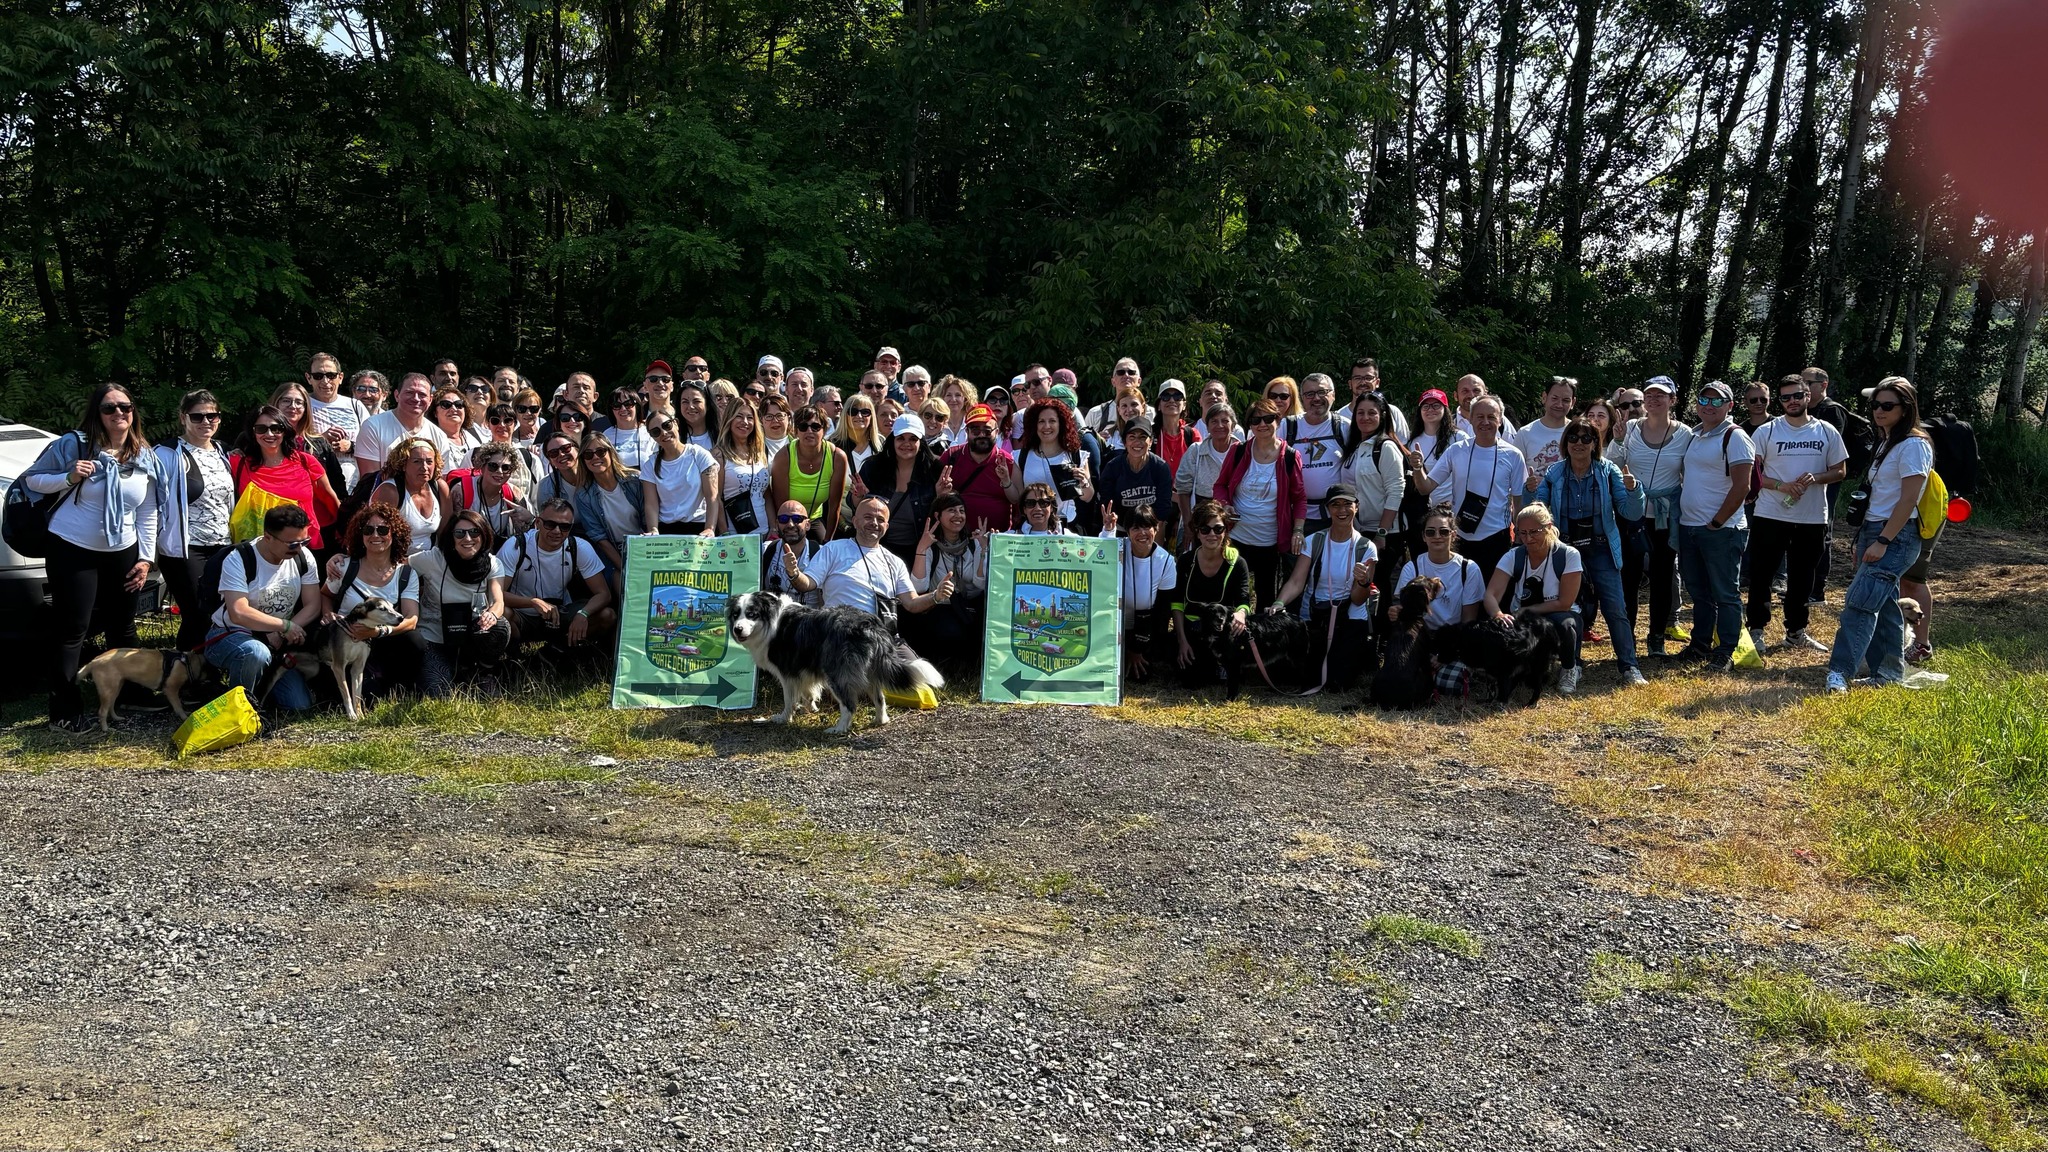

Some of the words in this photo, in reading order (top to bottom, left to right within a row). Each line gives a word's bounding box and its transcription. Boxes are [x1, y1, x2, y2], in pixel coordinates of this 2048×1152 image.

[1776, 440, 1824, 453] THRASHER
[1302, 461, 1334, 469] CONVERSE
[1121, 485, 1157, 499] SEATTLE
[653, 571, 729, 593] MANGIALONGA
[1016, 570, 1089, 593] MANGIALONGA
[652, 652, 672, 669] PORTE
[1017, 649, 1037, 666] PORTE
